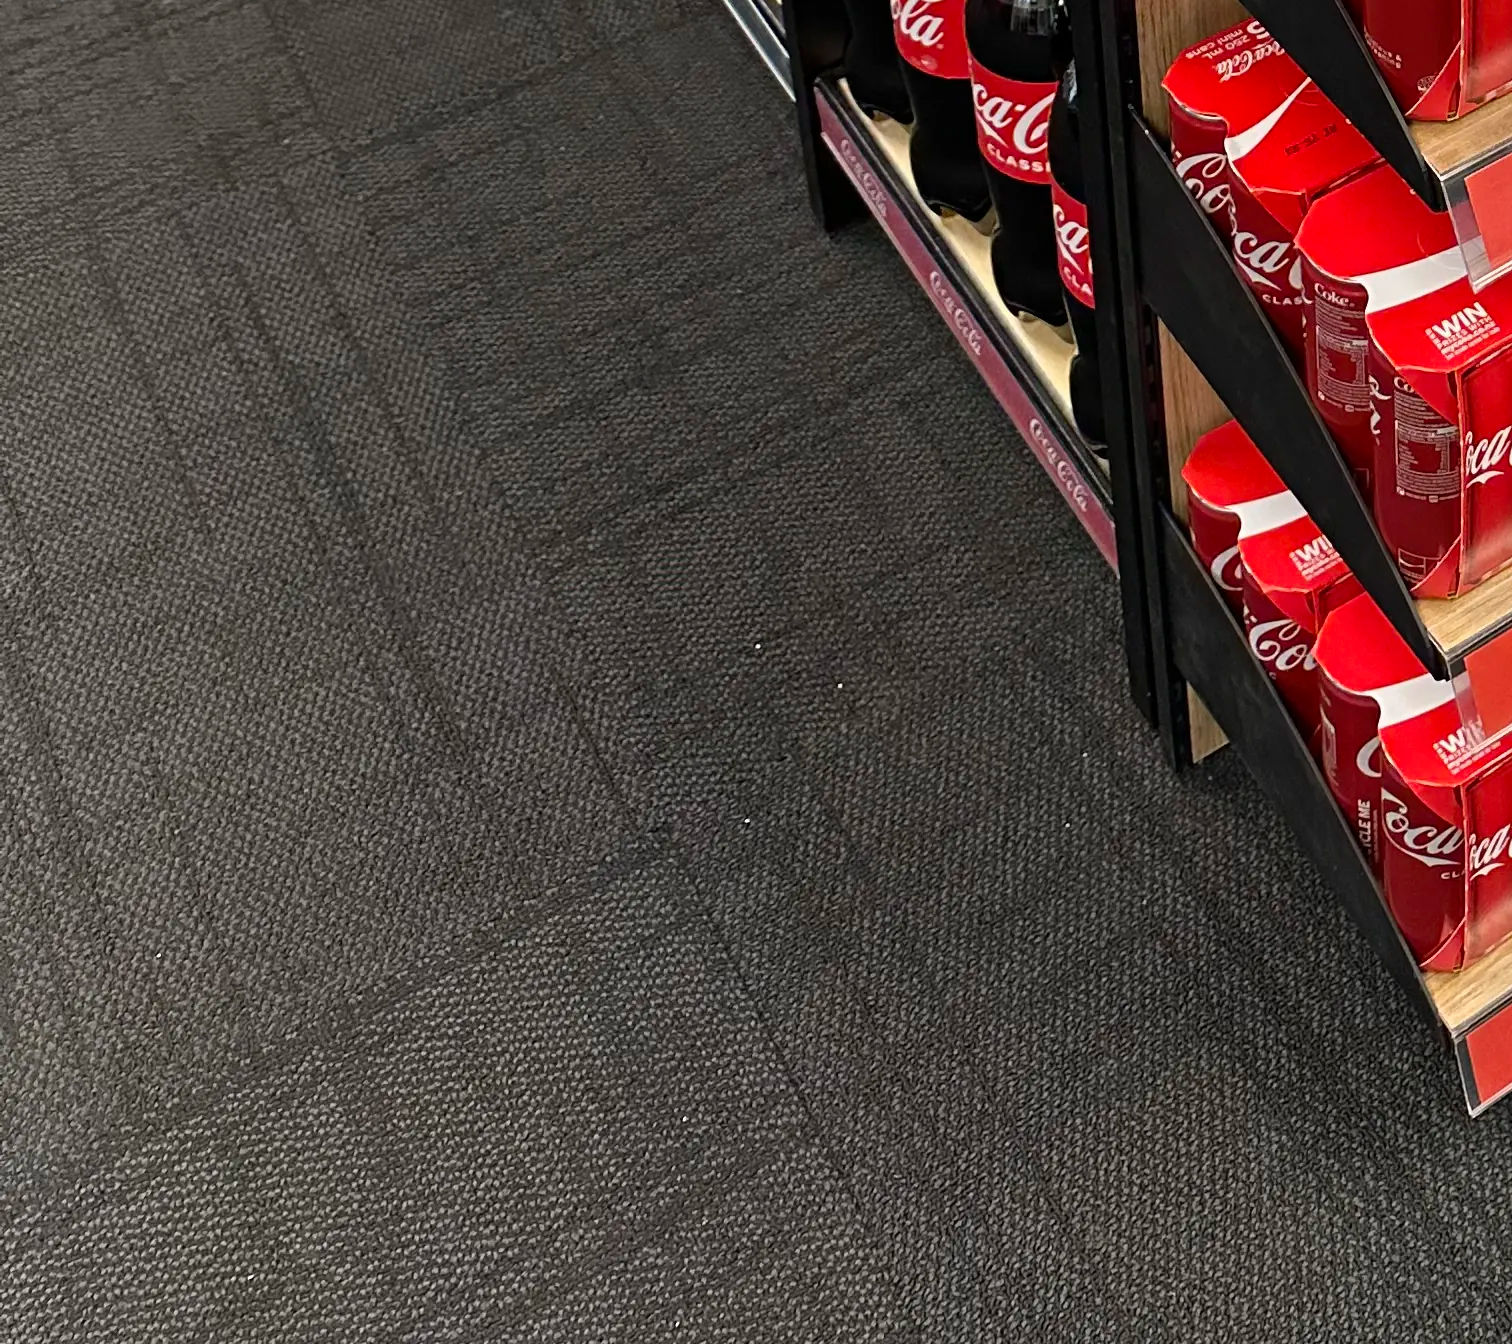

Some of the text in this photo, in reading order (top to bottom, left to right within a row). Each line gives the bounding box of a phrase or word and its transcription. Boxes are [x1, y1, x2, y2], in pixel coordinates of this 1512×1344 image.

[1314, 282, 1350, 306] Coke
[1432, 301, 1488, 338] WIN
[1029, 417, 1089, 513] Coca-Cola
